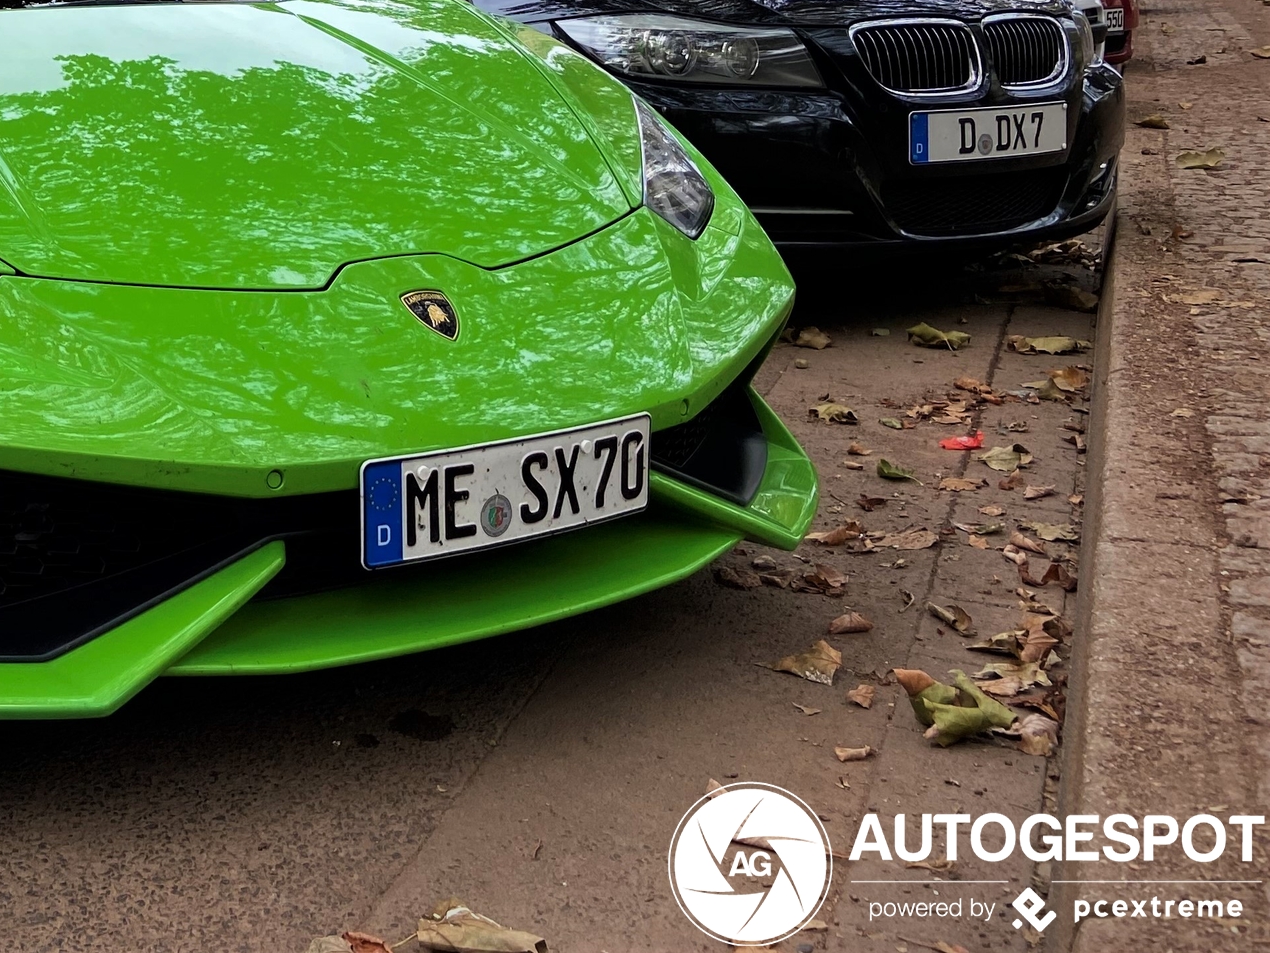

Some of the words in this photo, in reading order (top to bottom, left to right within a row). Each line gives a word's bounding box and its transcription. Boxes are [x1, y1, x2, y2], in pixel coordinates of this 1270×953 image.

[916, 143, 923, 154] D
[958, 117, 976, 154] D
[406, 463, 477, 547] ME
[378, 524, 391, 546] D
